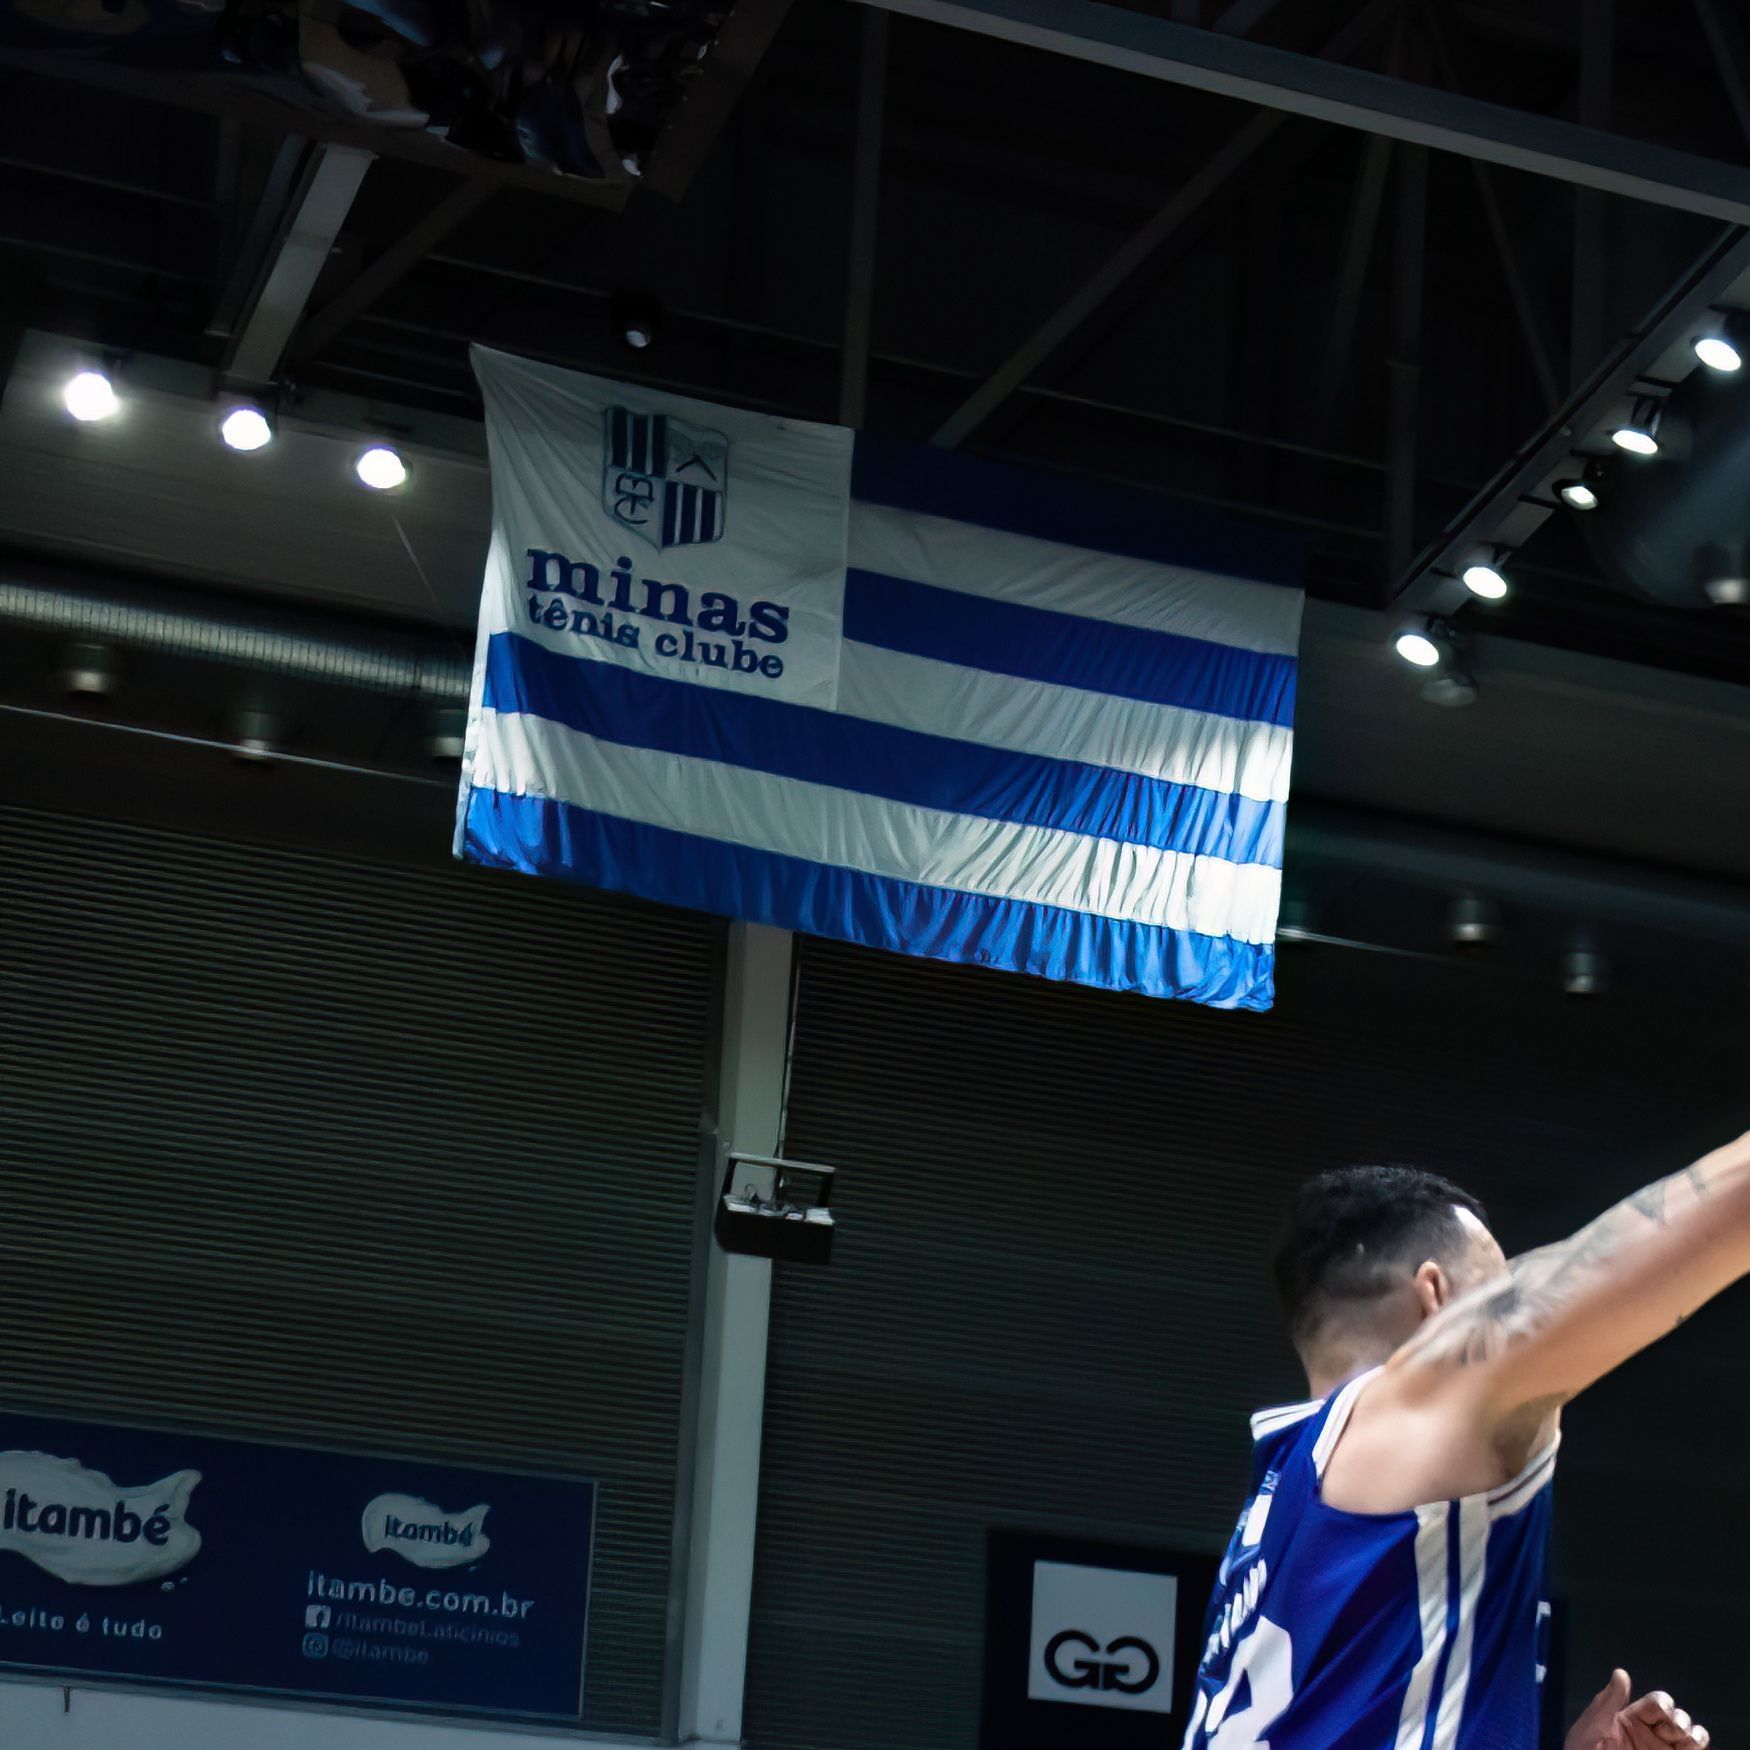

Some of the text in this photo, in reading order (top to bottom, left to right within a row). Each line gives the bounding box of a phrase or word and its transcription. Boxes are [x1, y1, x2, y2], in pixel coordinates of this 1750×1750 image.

[526, 548, 790, 644] minas
[528, 593, 784, 679] tênis clube
[4, 1488, 171, 1546] itambé
